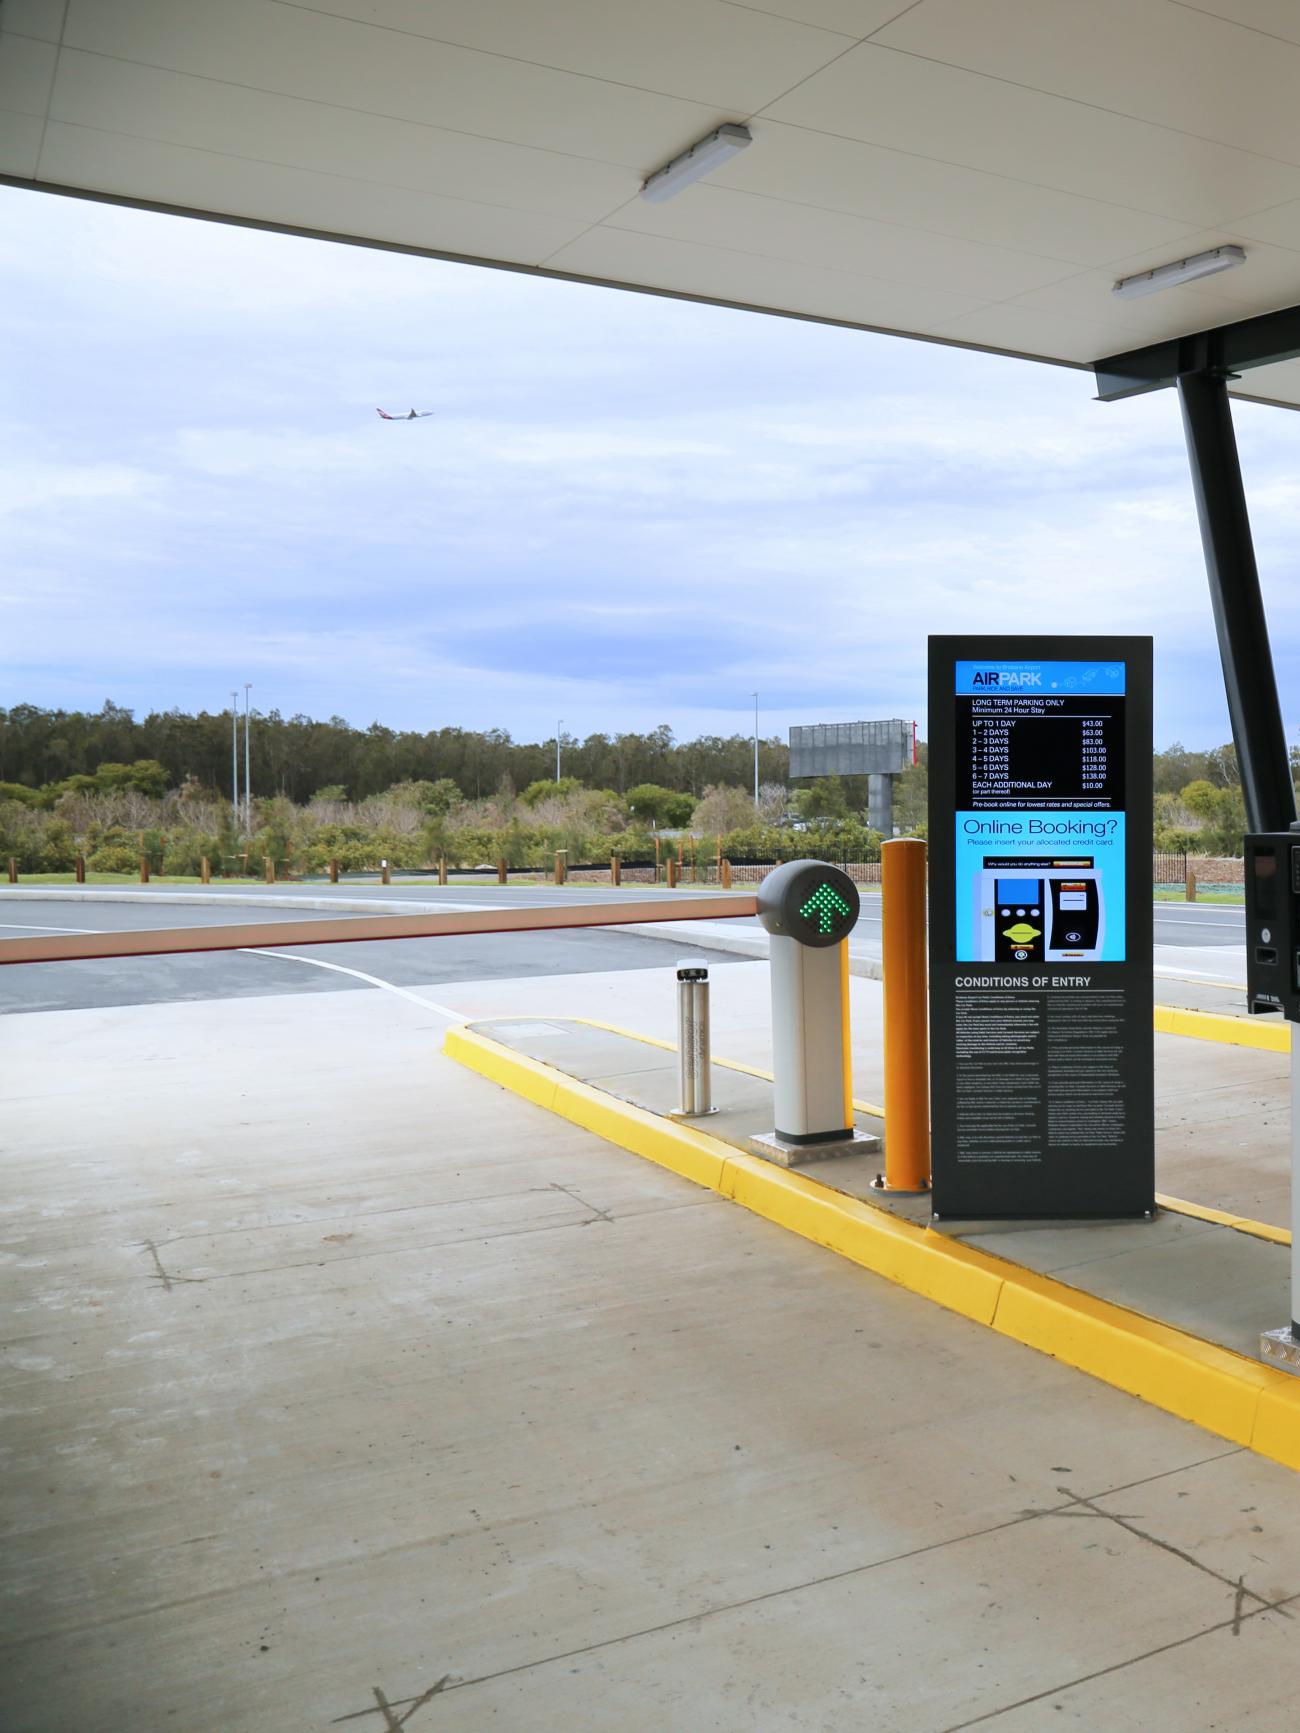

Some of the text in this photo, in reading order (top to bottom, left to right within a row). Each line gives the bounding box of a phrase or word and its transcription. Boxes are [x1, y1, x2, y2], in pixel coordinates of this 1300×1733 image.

[972, 672, 1042, 686] AIRPARK
[964, 820, 1118, 837] Online Booking?
[956, 977, 1091, 987] CONDITIONS OF ENTRY
